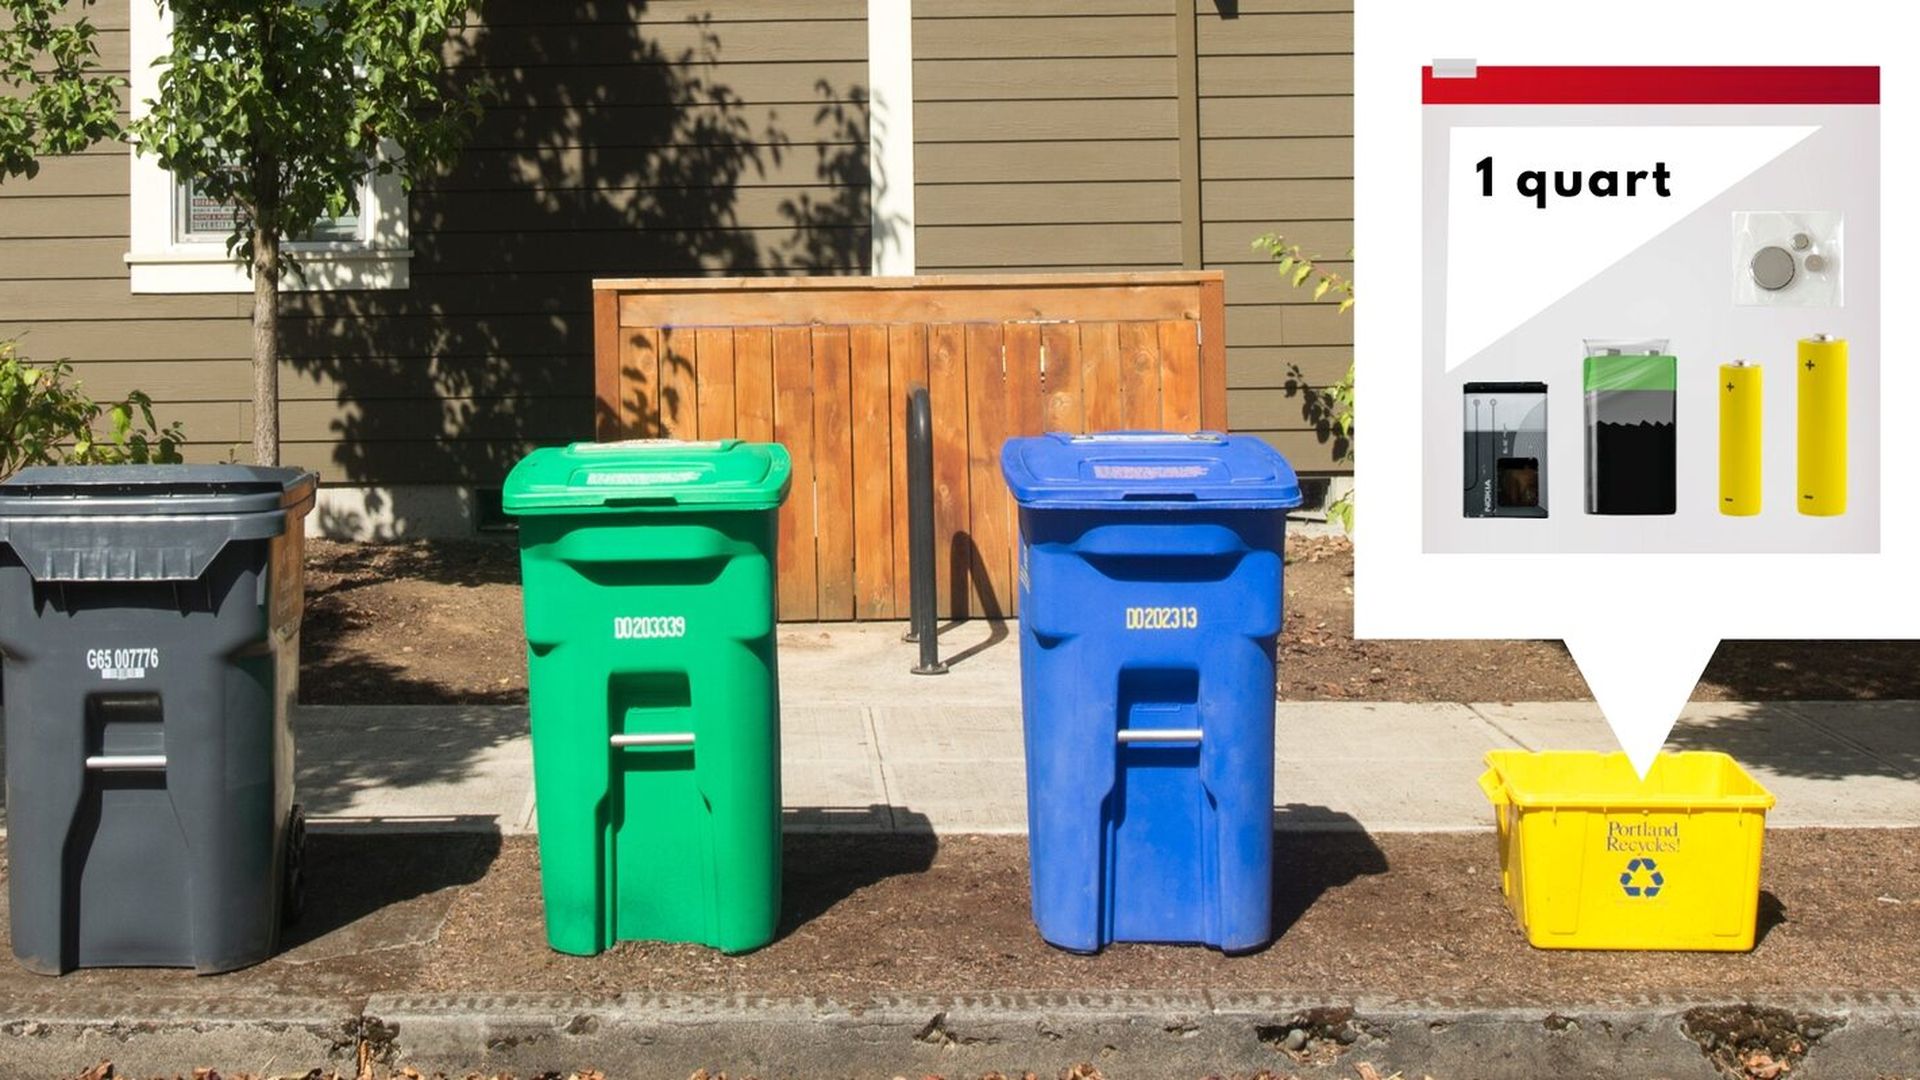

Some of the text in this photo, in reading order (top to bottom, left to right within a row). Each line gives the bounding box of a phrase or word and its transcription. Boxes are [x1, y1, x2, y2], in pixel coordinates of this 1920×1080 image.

[1484, 479, 1492, 512] NOKIA
[87, 647, 159, 670] G65 007776
[1608, 821, 1679, 837] Portland
[1606, 836, 1681, 856] Recycles!
